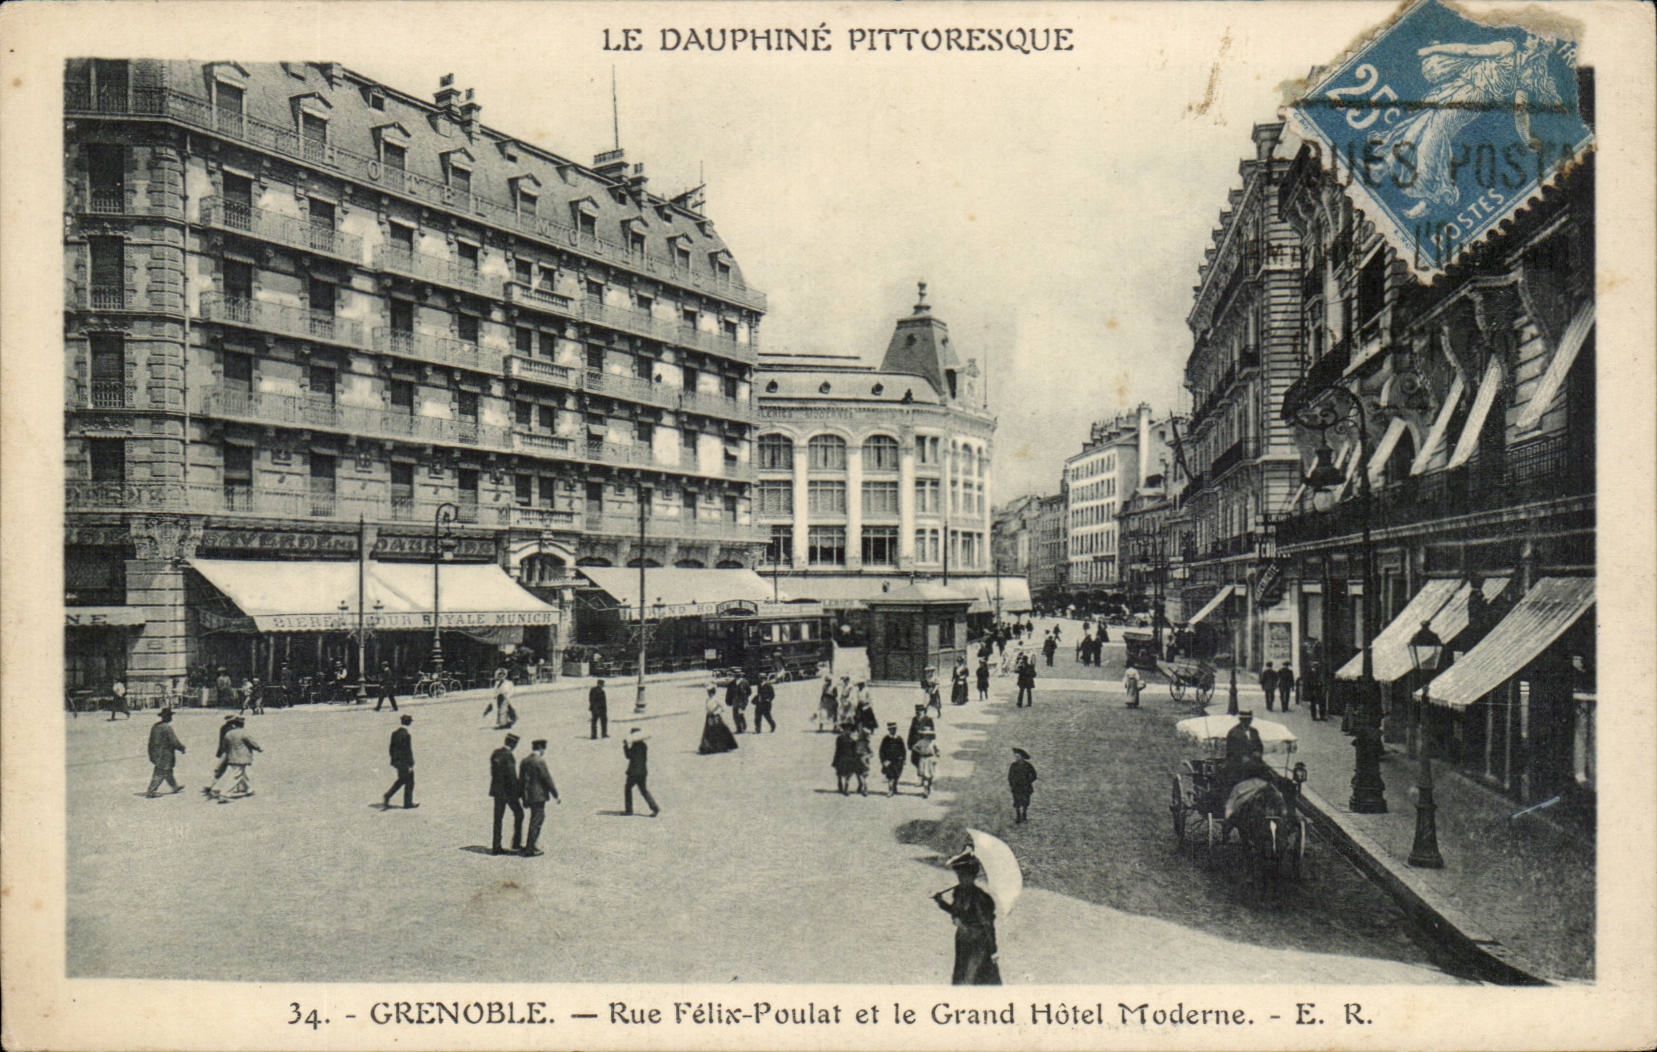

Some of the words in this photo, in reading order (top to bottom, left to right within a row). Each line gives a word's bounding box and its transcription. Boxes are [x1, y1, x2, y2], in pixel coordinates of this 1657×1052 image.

[1429, 187, 1505, 251] POSTES
[422, 612, 486, 625] ROYALE
[495, 611, 553, 623] MUNICH
